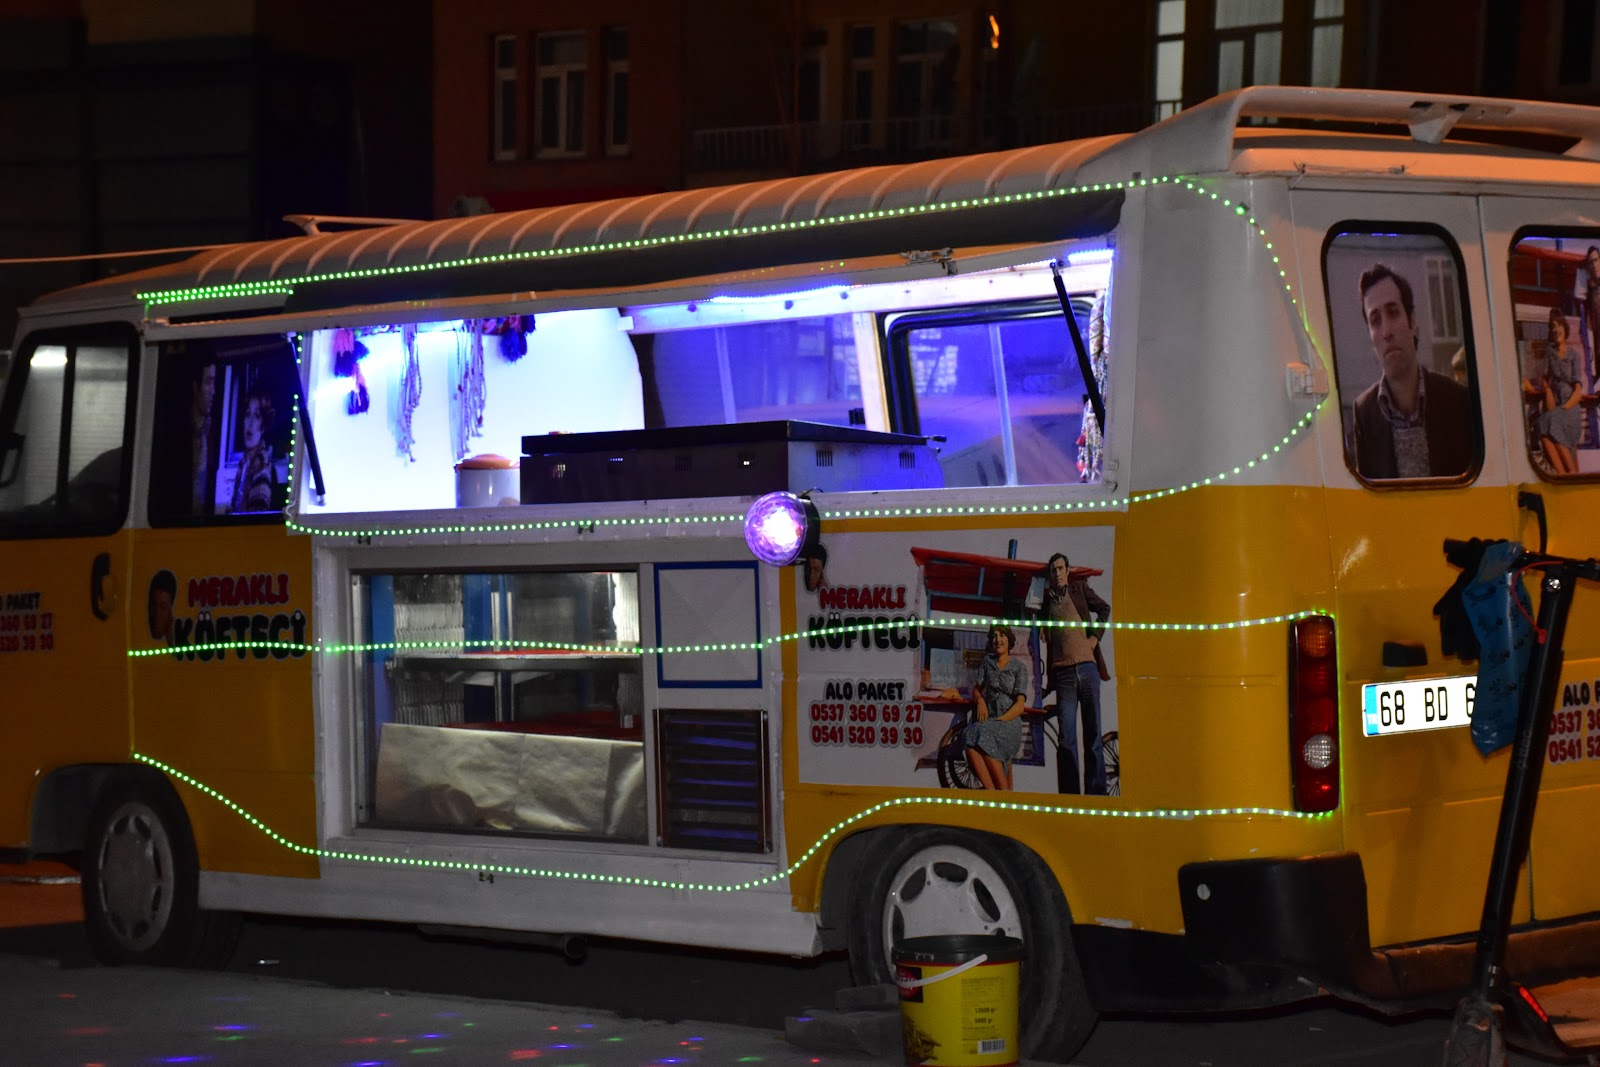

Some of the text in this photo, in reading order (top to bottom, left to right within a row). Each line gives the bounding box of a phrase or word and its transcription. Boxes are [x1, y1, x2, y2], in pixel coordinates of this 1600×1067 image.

[188, 573, 289, 607] MERAKLI
[819, 586, 906, 609] MERAKLI
[825, 682, 904, 700] ALO PAKET
[1563, 682, 1590, 706] ALO
[811, 704, 922, 722] 0537 360 69 27
[1380, 689, 1405, 726] 68
[1424, 686, 1448, 722] BD
[811, 725, 923, 745] 0541 520 39 30
[1548, 738, 1582, 762] 0541
